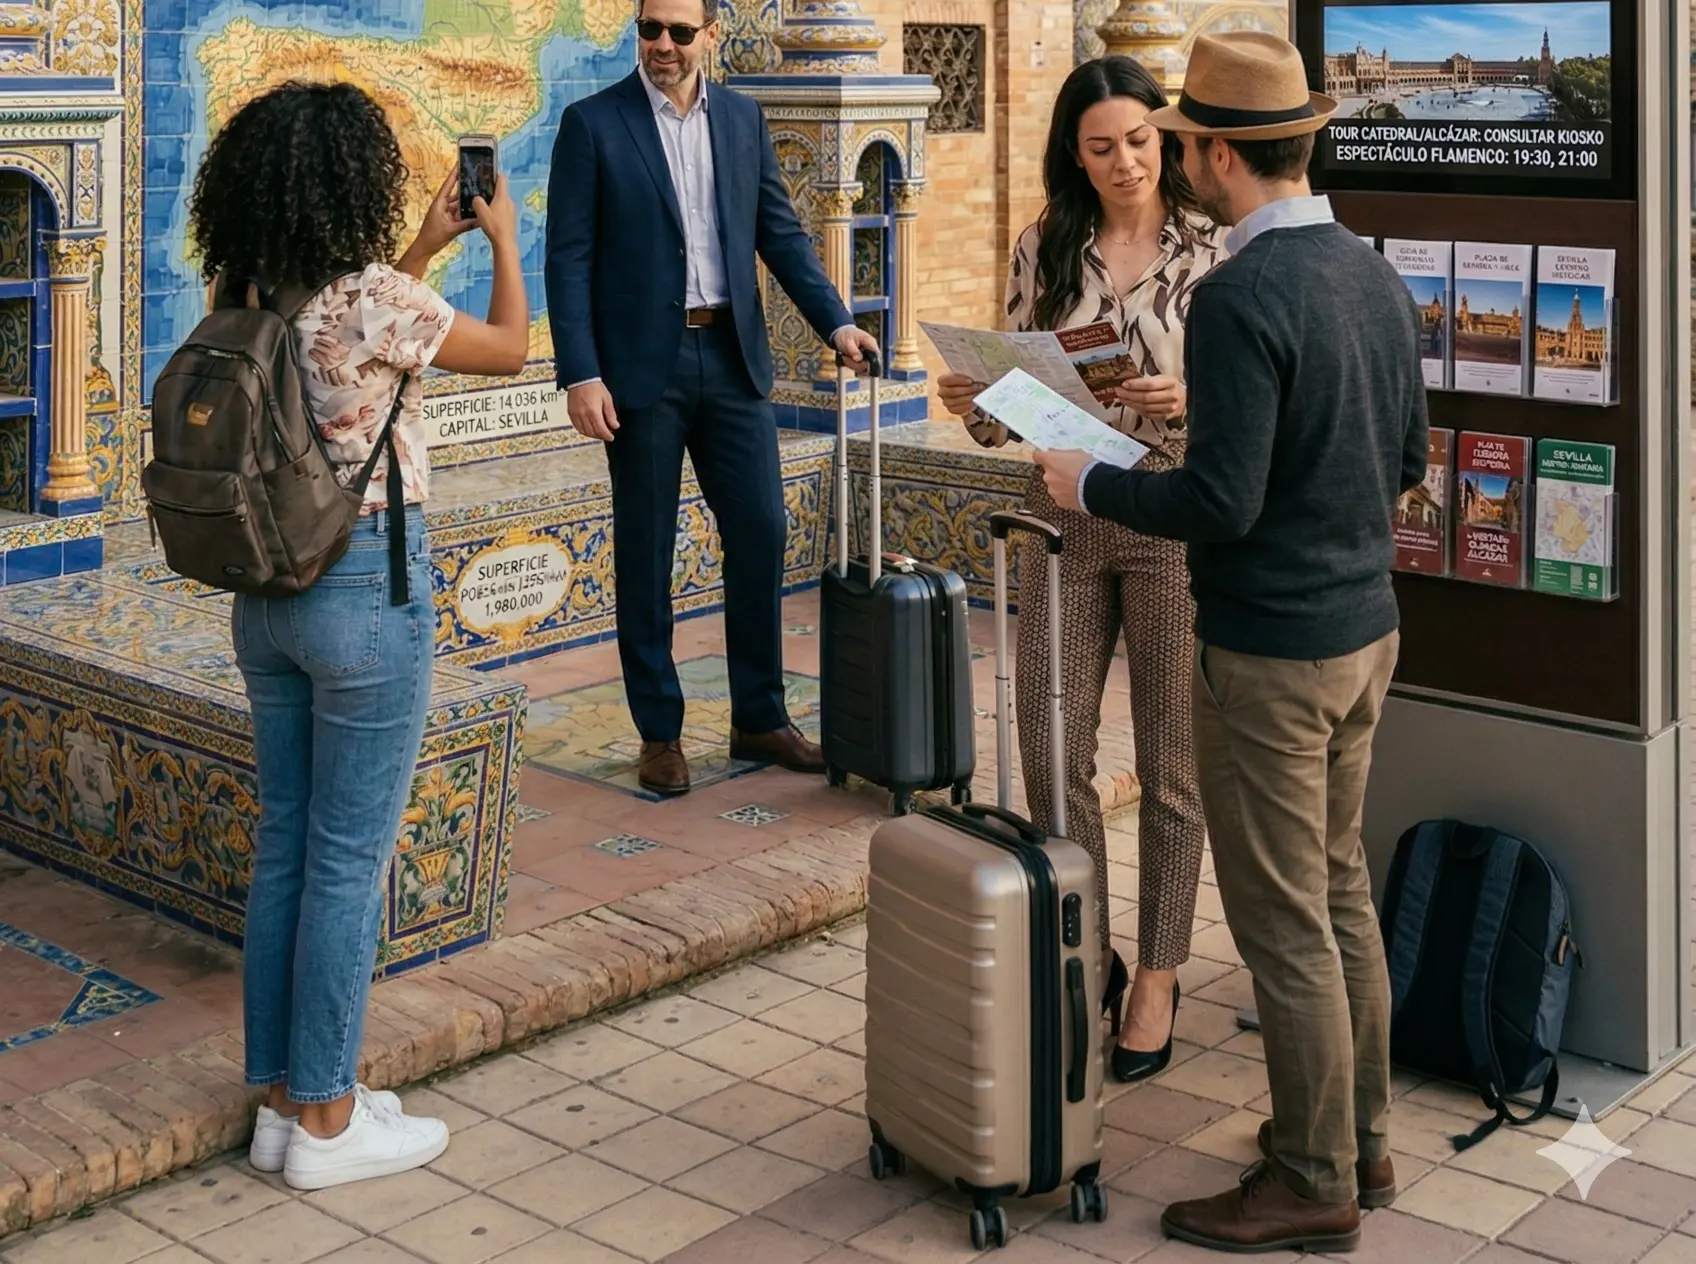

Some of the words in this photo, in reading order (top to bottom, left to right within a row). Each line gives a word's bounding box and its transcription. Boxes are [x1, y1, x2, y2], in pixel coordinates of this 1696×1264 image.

[1329, 126, 1358, 140] TOUR
[1361, 125, 1481, 143] CATEDRAL/ALCÁZAR:
[1484, 128, 1555, 144] CONSULTAR
[1558, 129, 1604, 145] KIOSKO
[1336, 143, 1426, 163] ESPECTÁCULO
[1431, 148, 1509, 164] FLAMENCO:
[1514, 149, 1554, 167] 19:30,
[1559, 150, 1598, 167] 21:00
[423, 397, 496, 420] SUPERFICIE:
[440, 418, 495, 437] CAPITAL:
[499, 409, 548, 429] SEVILLA
[1553, 450, 1592, 463] SEVILLA
[478, 553, 548, 581] SUPERFICIE
